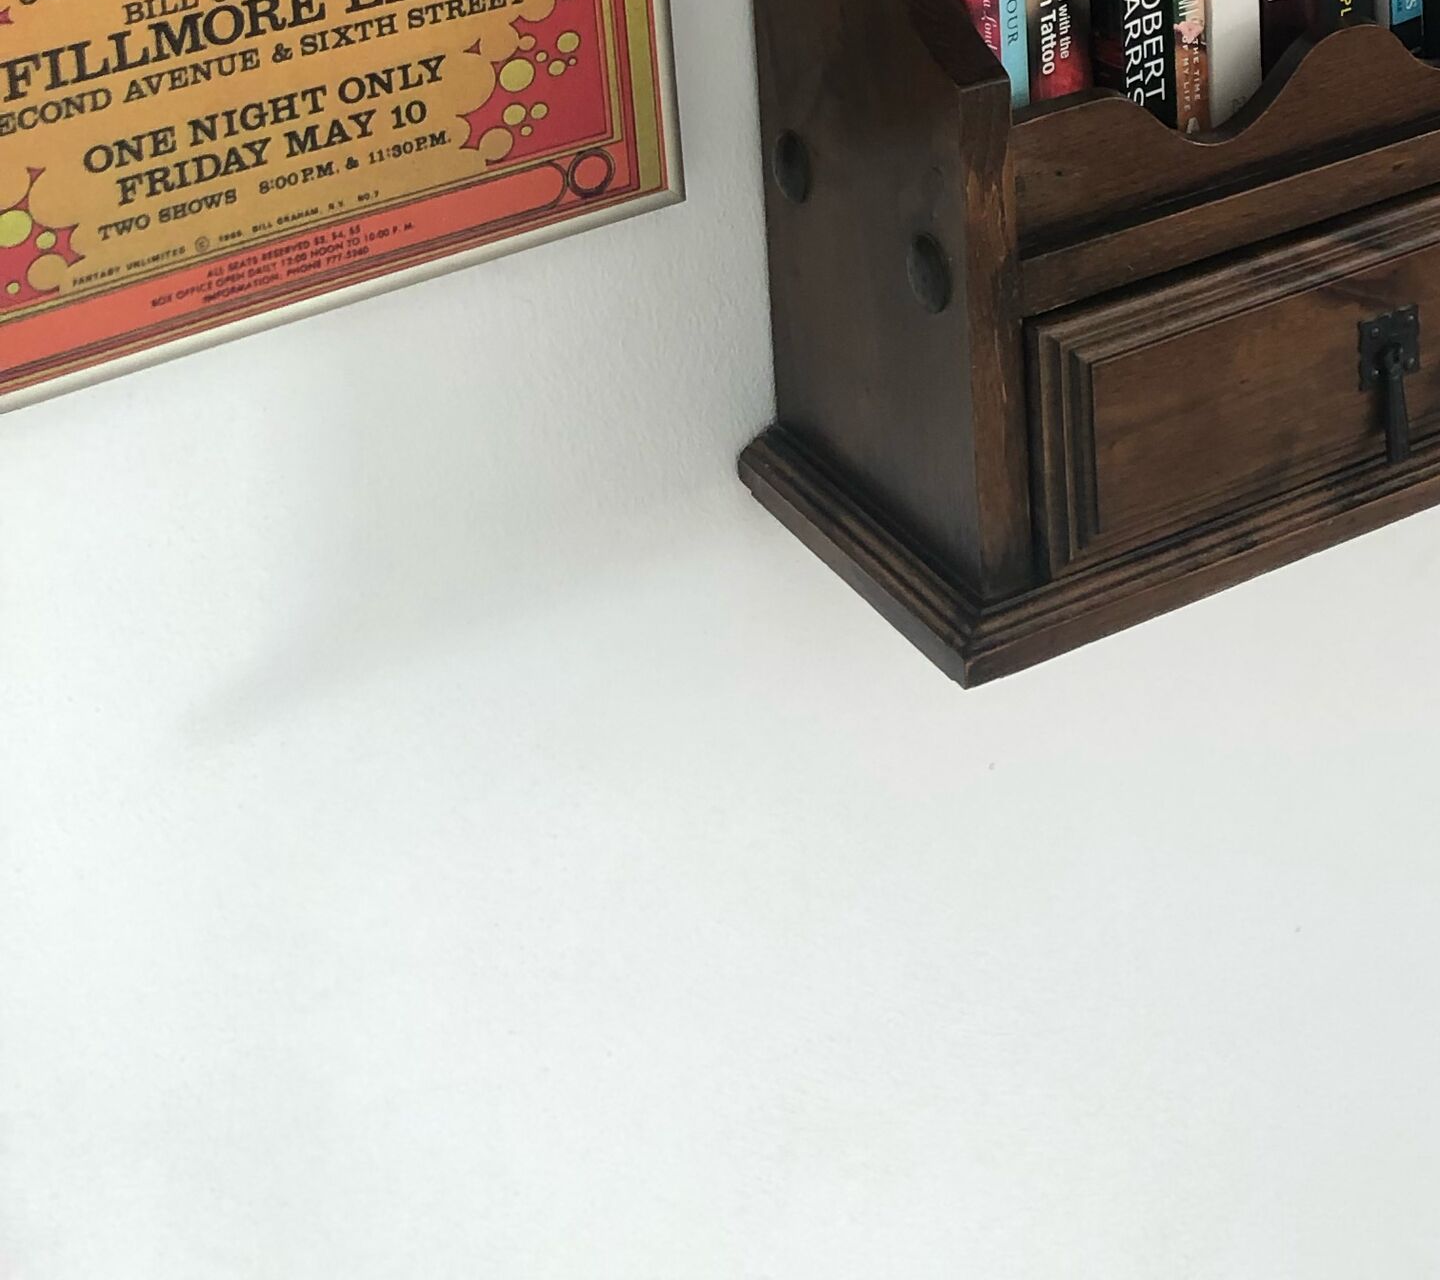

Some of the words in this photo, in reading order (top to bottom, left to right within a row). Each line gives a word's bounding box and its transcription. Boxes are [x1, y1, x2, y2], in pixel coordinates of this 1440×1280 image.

[122, 47, 261, 105] AVENUE
[270, 42, 294, 64] &
[299, 12, 398, 57] SIXTH
[83, 119, 177, 175] ONE
[187, 84, 330, 144] NIGHT
[337, 53, 449, 106] ONLY
[115, 139, 273, 207] FRIDAY
[284, 106, 379, 160] MAY
[390, 99, 429, 133] 10
[96, 212, 152, 242] TWO
[158, 187, 239, 225] SHOWS
[344, 154, 360, 171] &
